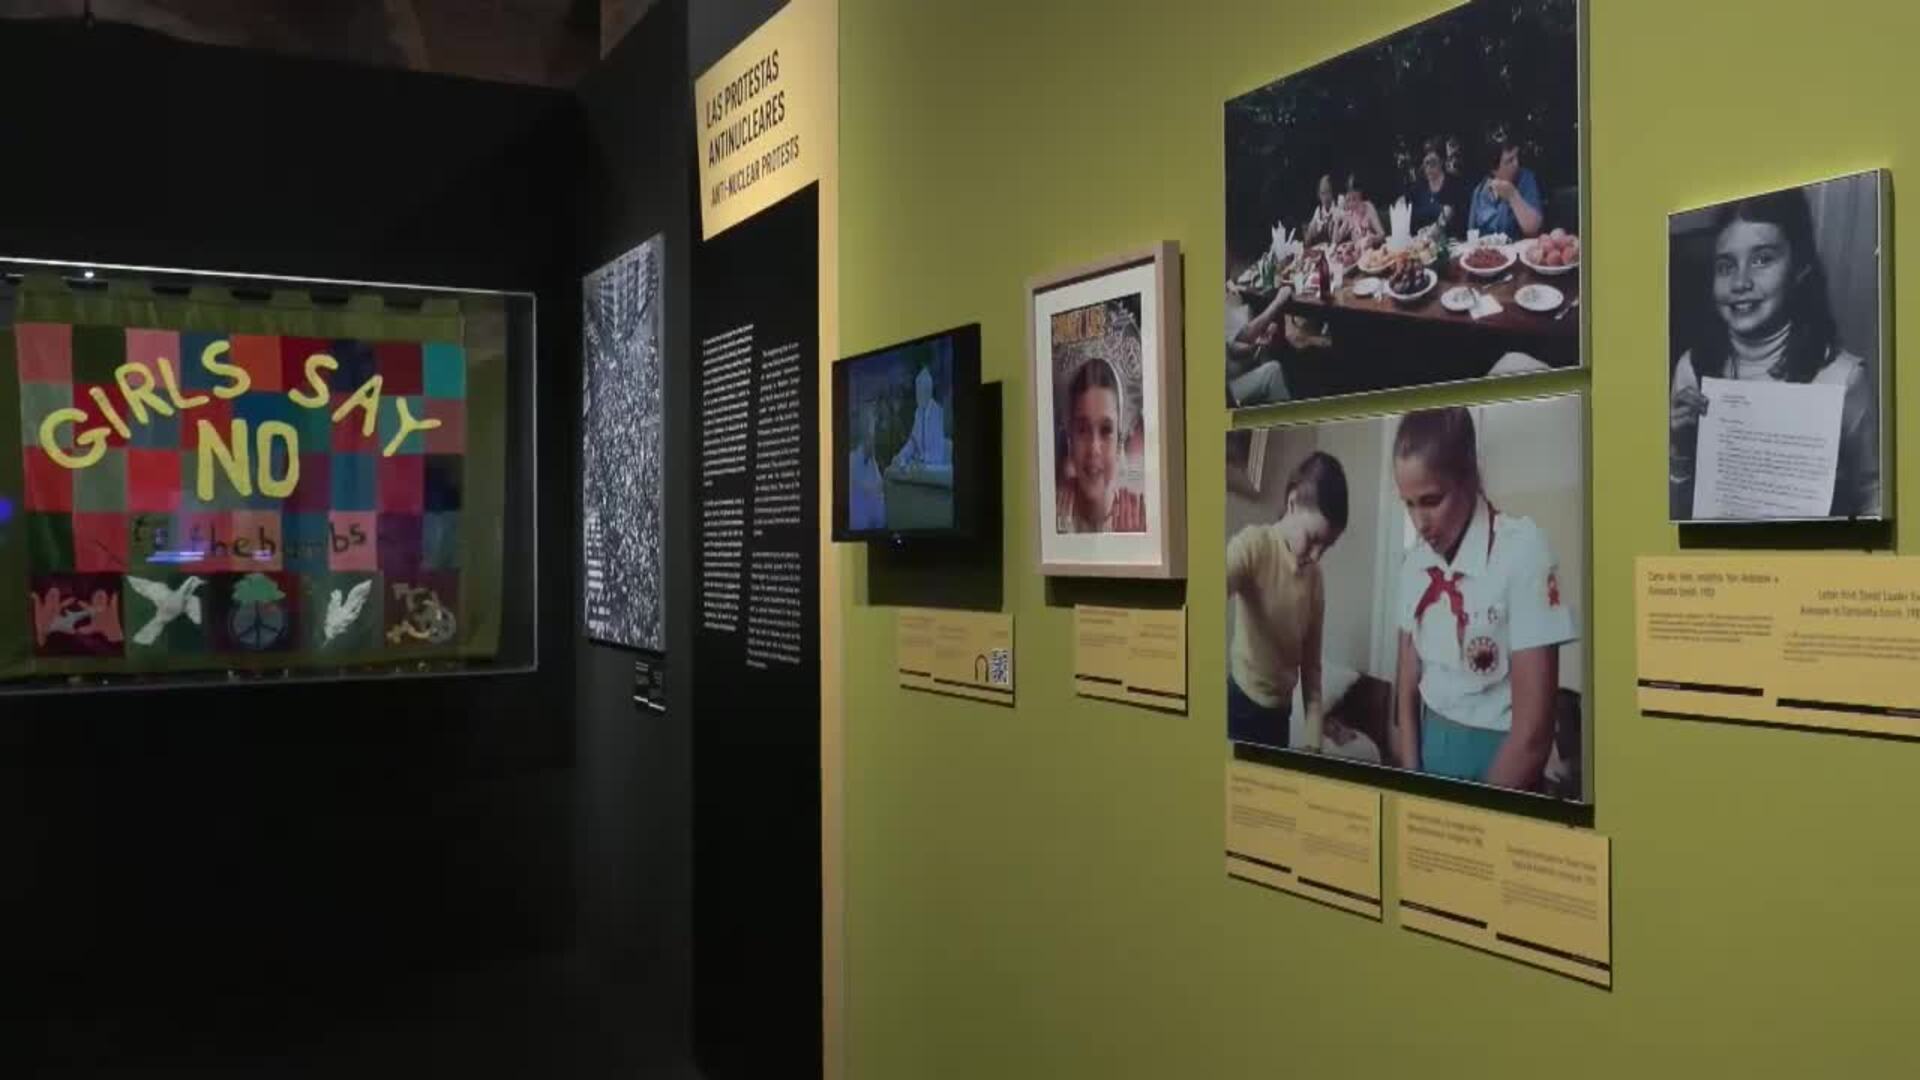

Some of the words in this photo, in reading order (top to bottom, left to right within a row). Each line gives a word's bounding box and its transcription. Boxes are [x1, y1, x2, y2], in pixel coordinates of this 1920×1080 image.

[706, 93, 723, 129] LAS
[725, 49, 780, 116] PROTESTAS
[708, 90, 786, 169] ANTINUCLEARES
[711, 159, 761, 208] ANTI-NUCLEAR
[761, 134, 800, 179] PROTESTS
[39, 340, 251, 469] GIRLS
[289, 354, 442, 457] SAY
[197, 418, 300, 501] NO
